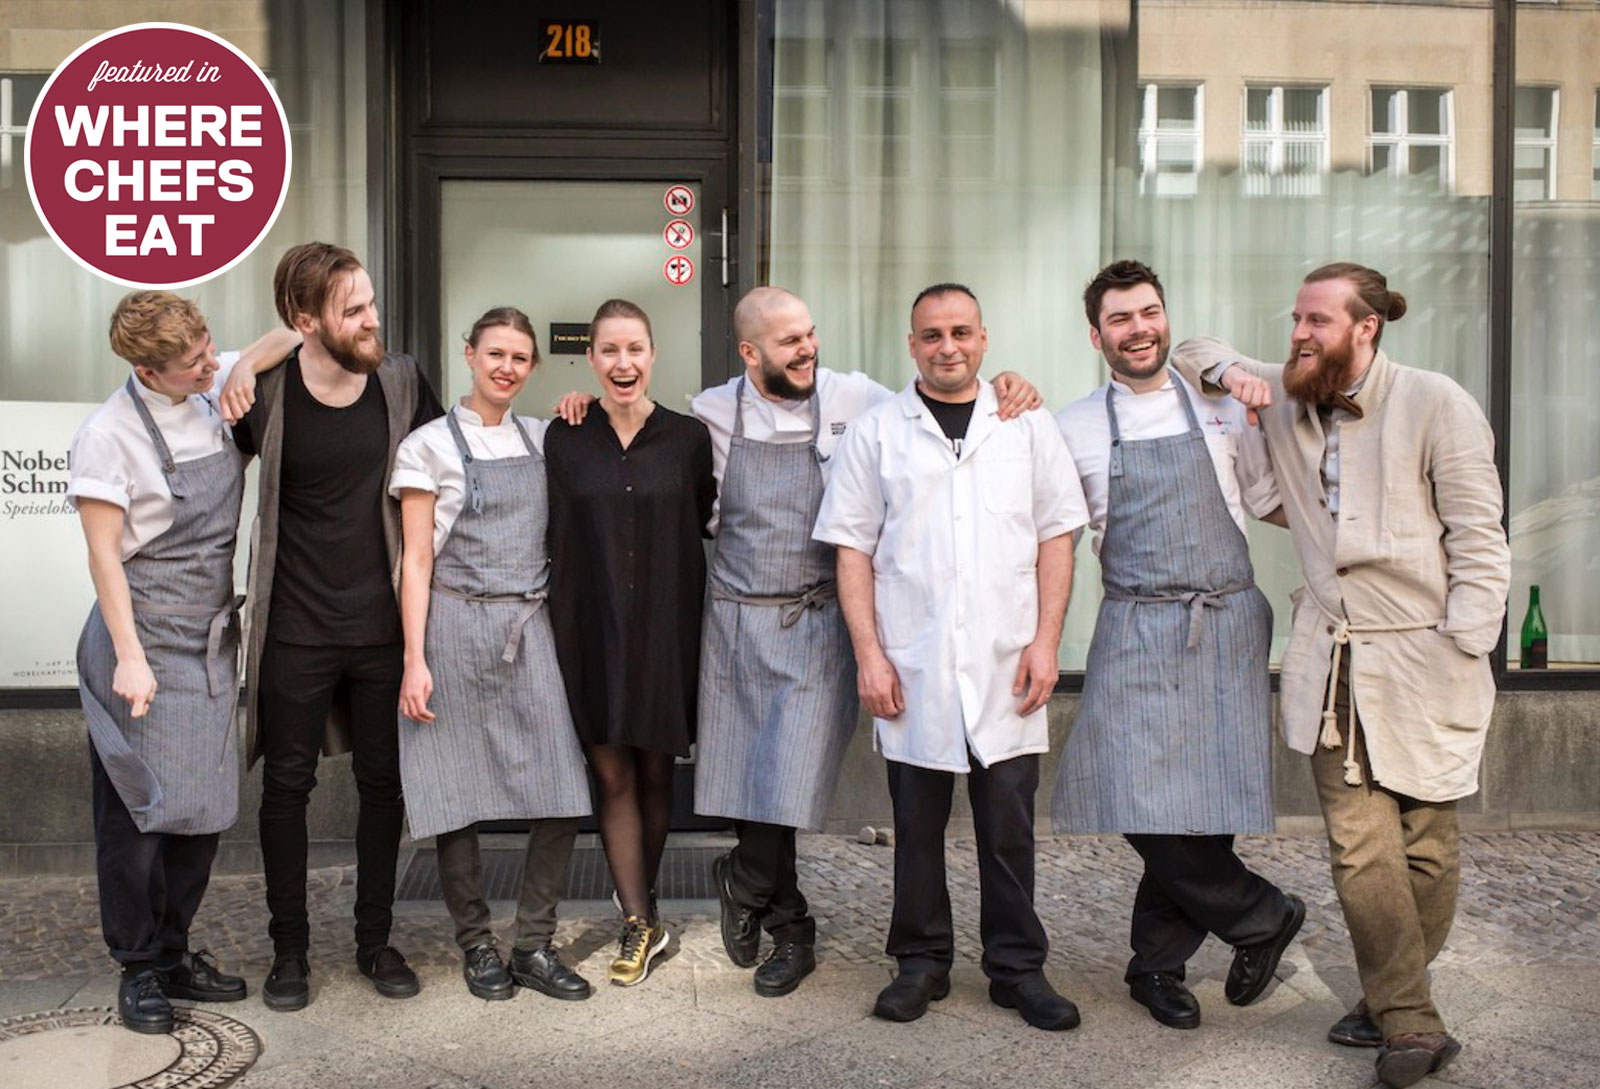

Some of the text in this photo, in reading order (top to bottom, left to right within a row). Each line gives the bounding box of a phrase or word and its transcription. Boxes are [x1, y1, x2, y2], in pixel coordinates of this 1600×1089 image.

[547, 24, 591, 57] 218
[1, 449, 71, 471] Nobel
[2, 473, 68, 494] Schm
